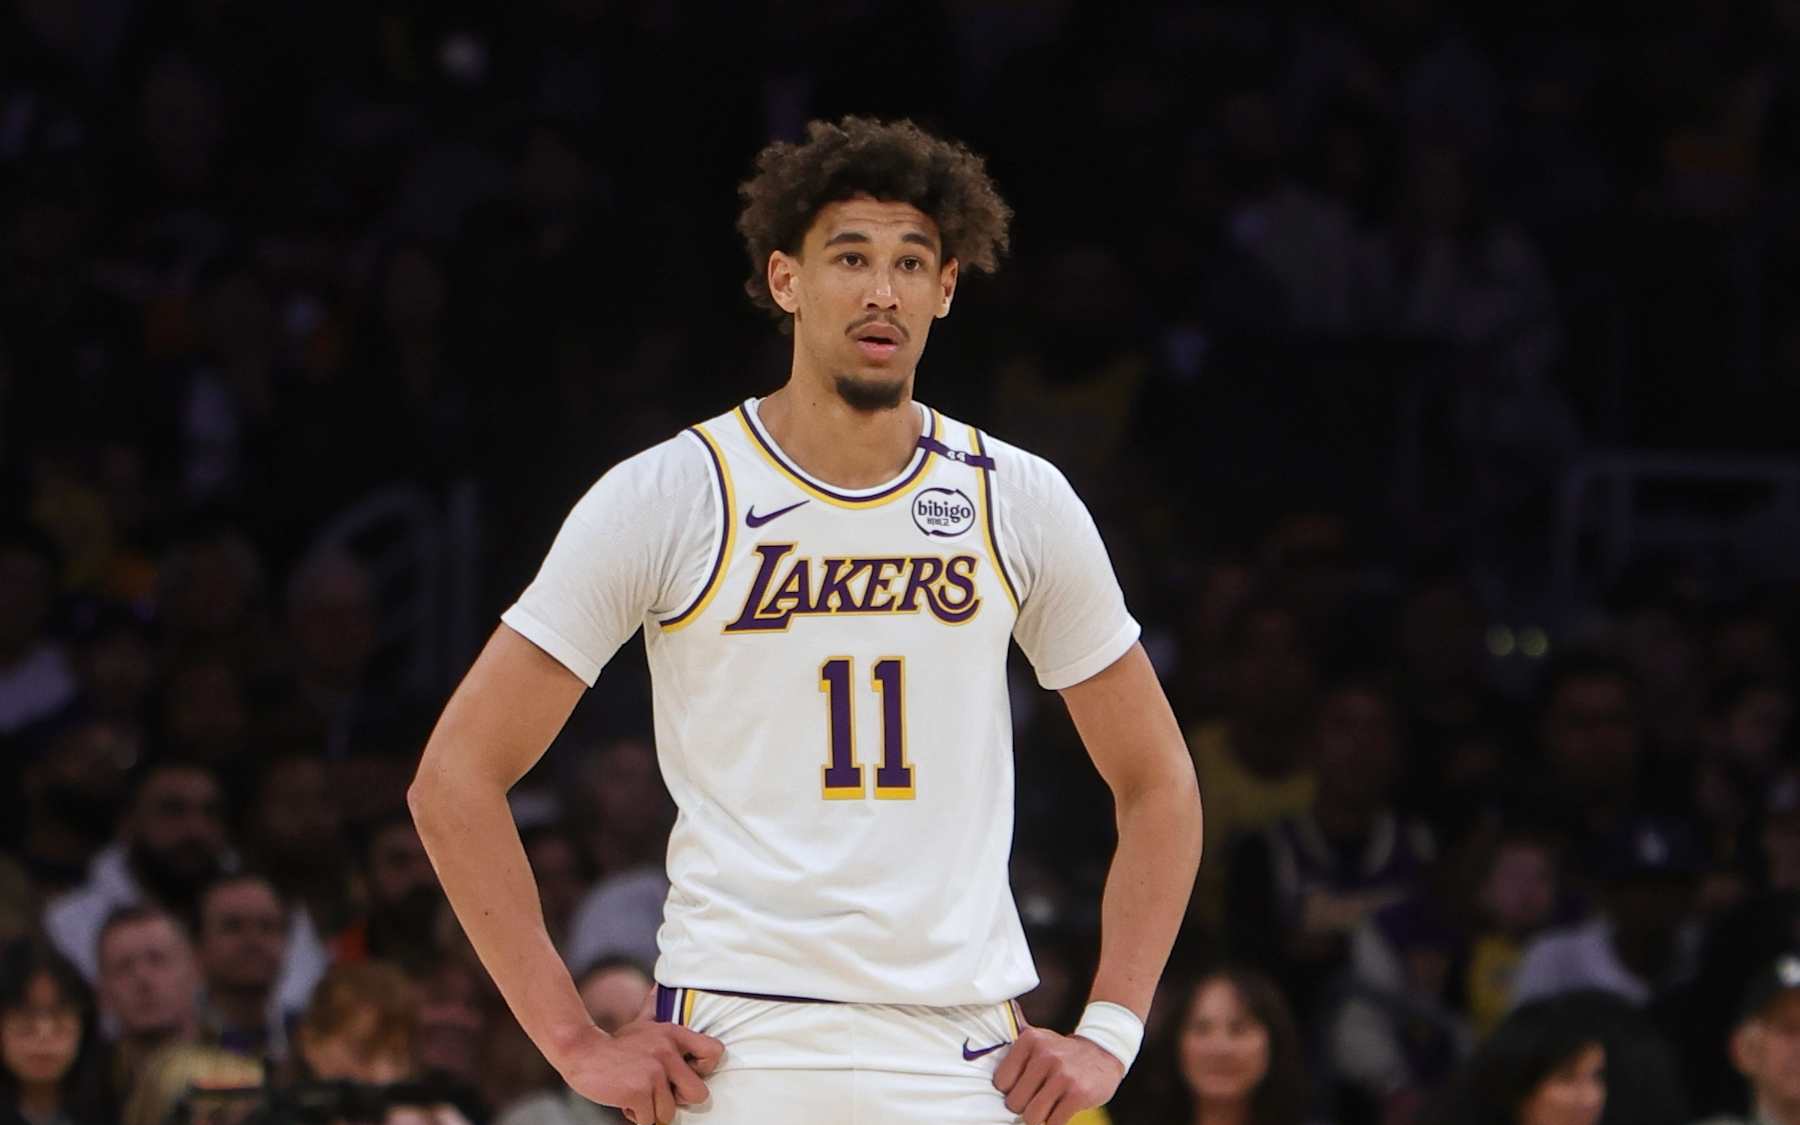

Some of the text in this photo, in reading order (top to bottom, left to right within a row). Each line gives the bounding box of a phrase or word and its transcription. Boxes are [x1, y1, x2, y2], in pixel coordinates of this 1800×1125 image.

[917, 500, 971, 523] bibigo
[721, 541, 984, 636] LAKERS
[818, 656, 916, 800] 11
